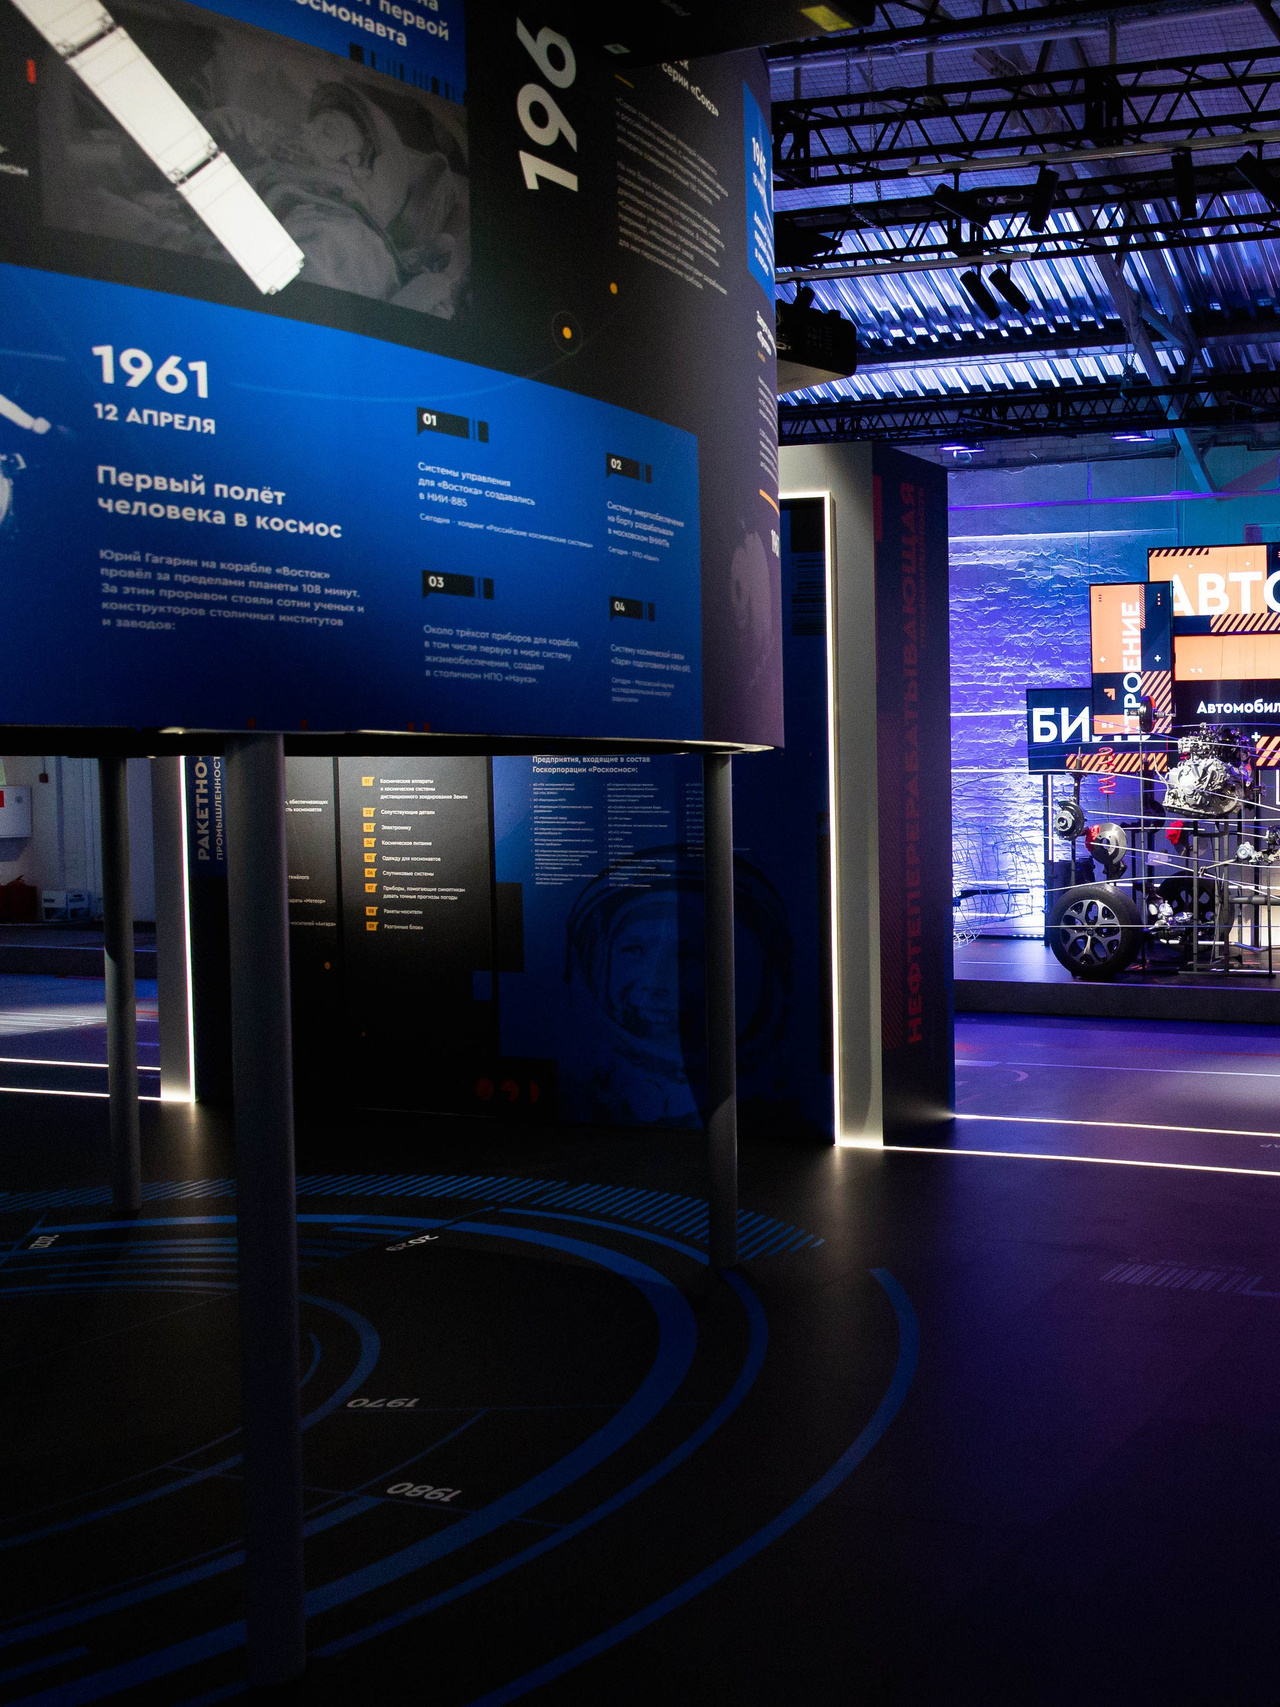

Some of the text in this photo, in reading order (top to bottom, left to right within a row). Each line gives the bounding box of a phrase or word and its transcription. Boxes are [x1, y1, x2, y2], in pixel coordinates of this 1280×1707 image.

[290, 0, 408, 47] смонавта
[378, 0, 450, 41] первой
[661, 62, 689, 91] серии
[516, 16, 578, 192] 196
[92, 345, 208, 398] 1961
[93, 403, 216, 434] 12 АПРЕЛЯ
[422, 413, 437, 426] 01
[417, 461, 511, 487] Системы управления
[611, 458, 622, 470] 02
[97, 464, 286, 506] Первый полёт
[418, 477, 536, 506] для «Востока» создавались
[427, 492, 468, 507] НИИ-885
[97, 497, 342, 538] человека в космос
[419, 513, 451, 524] Сегодня
[99, 549, 330, 580] Юрий Гагарин на корабле «Восток»
[100, 566, 361, 599] провёл за пределами планеты 108 минут.
[428, 576, 444, 588] 03
[101, 582, 365, 613] За этим прорывом стояли сотни ученых и
[614, 601, 625, 612] 04
[101, 601, 344, 627] конструкторов столичных институтов
[101, 618, 176, 631] и заводов:
[423, 624, 454, 636] Около
[456, 628, 489, 639] трёхсот
[491, 631, 532, 644] приборов
[533, 636, 547, 645] для
[425, 655, 545, 671] жизнеобеспечения, создали
[432, 642, 450, 650] том
[451, 643, 478, 652] числе
[479, 646, 512, 657] первую
[520, 649, 540, 658] мире
[542, 651, 572, 662] систему
[425, 669, 431, 677] в
[433, 670, 481, 680] столичном
[483, 672, 503, 681] НПО
[1121, 602, 1142, 734] ТРОЕНИЕ
[1032, 706, 1151, 743] БИ
[532, 756, 581, 765] Предприятия,
[532, 766, 638, 774] Госкорпорации «Роскосмос»:
[194, 756, 210, 861] РАКЕТНО-
[213, 756, 224, 861] ПРОМЫШЛЕННОСТ
[346, 1398, 420, 1408] 1970
[386, 1482, 462, 1502] 1980
